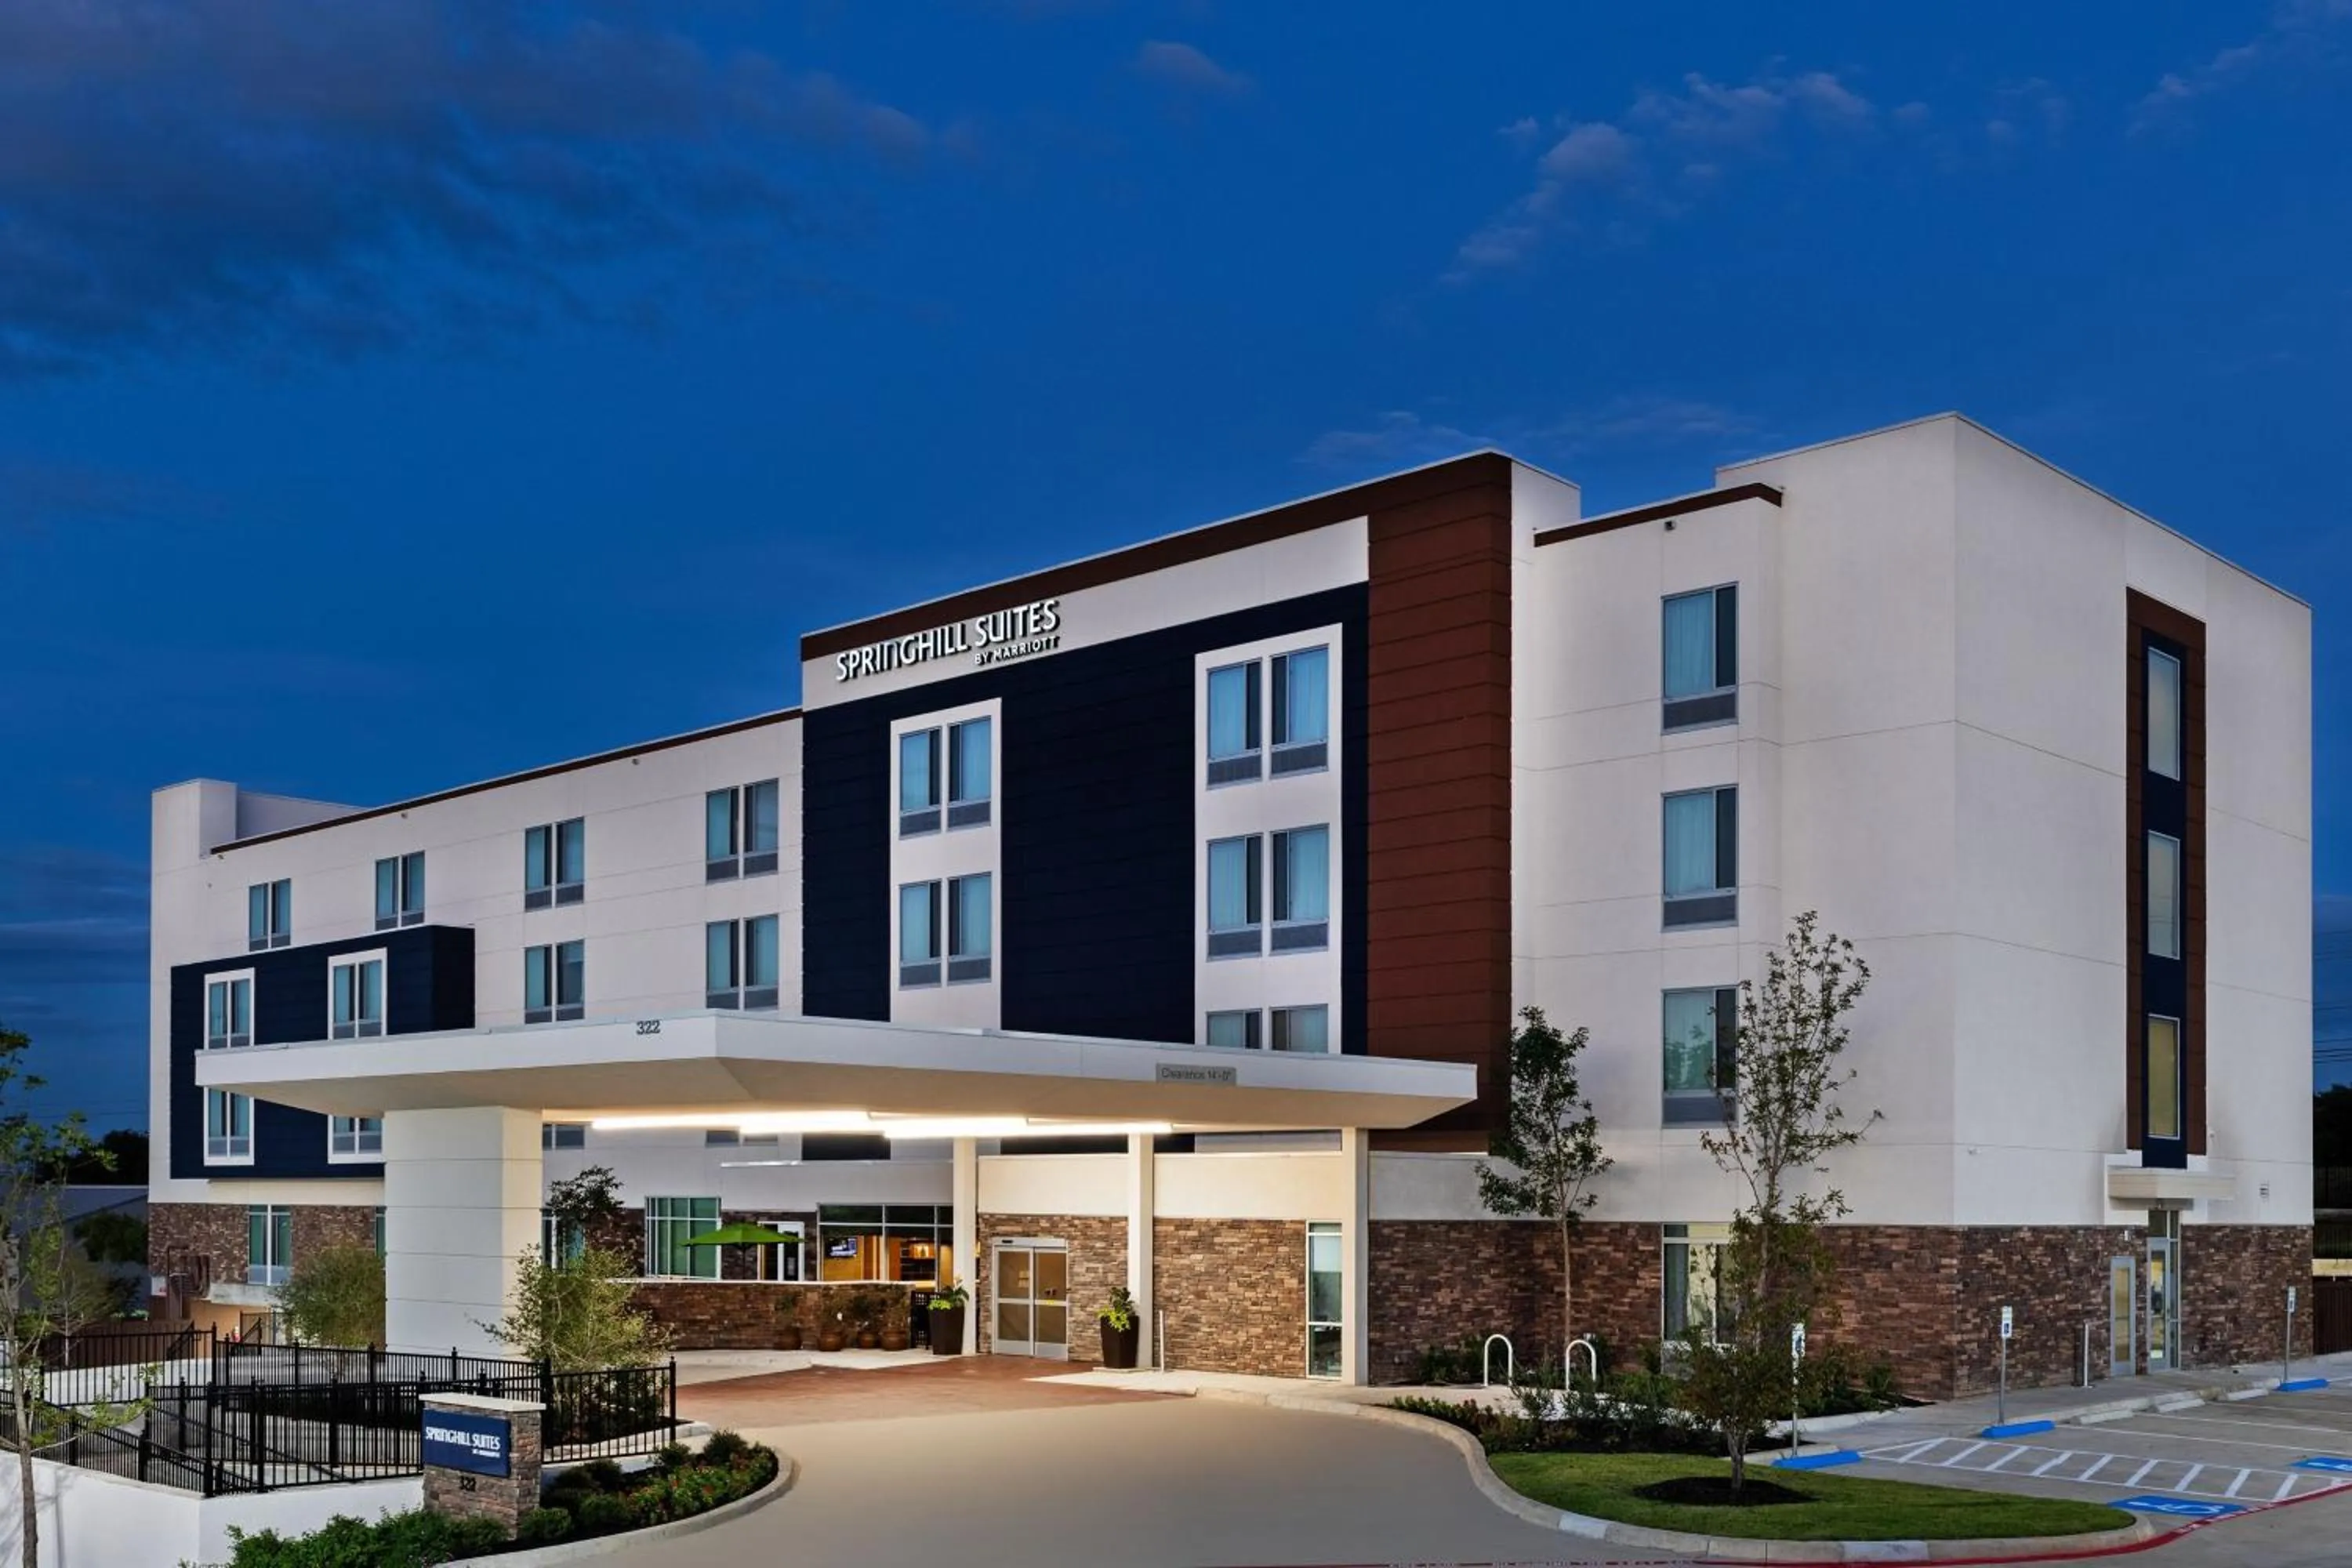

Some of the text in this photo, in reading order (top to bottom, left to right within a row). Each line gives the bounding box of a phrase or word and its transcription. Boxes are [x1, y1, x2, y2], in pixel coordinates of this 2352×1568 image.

[836, 600, 1058, 681] SPRINGHILL SUITES
[975, 636, 1058, 665] BY MARRIOTT
[636, 1020, 661, 1035] 322
[426, 1426, 501, 1450] SPRINGHILL SUITES
